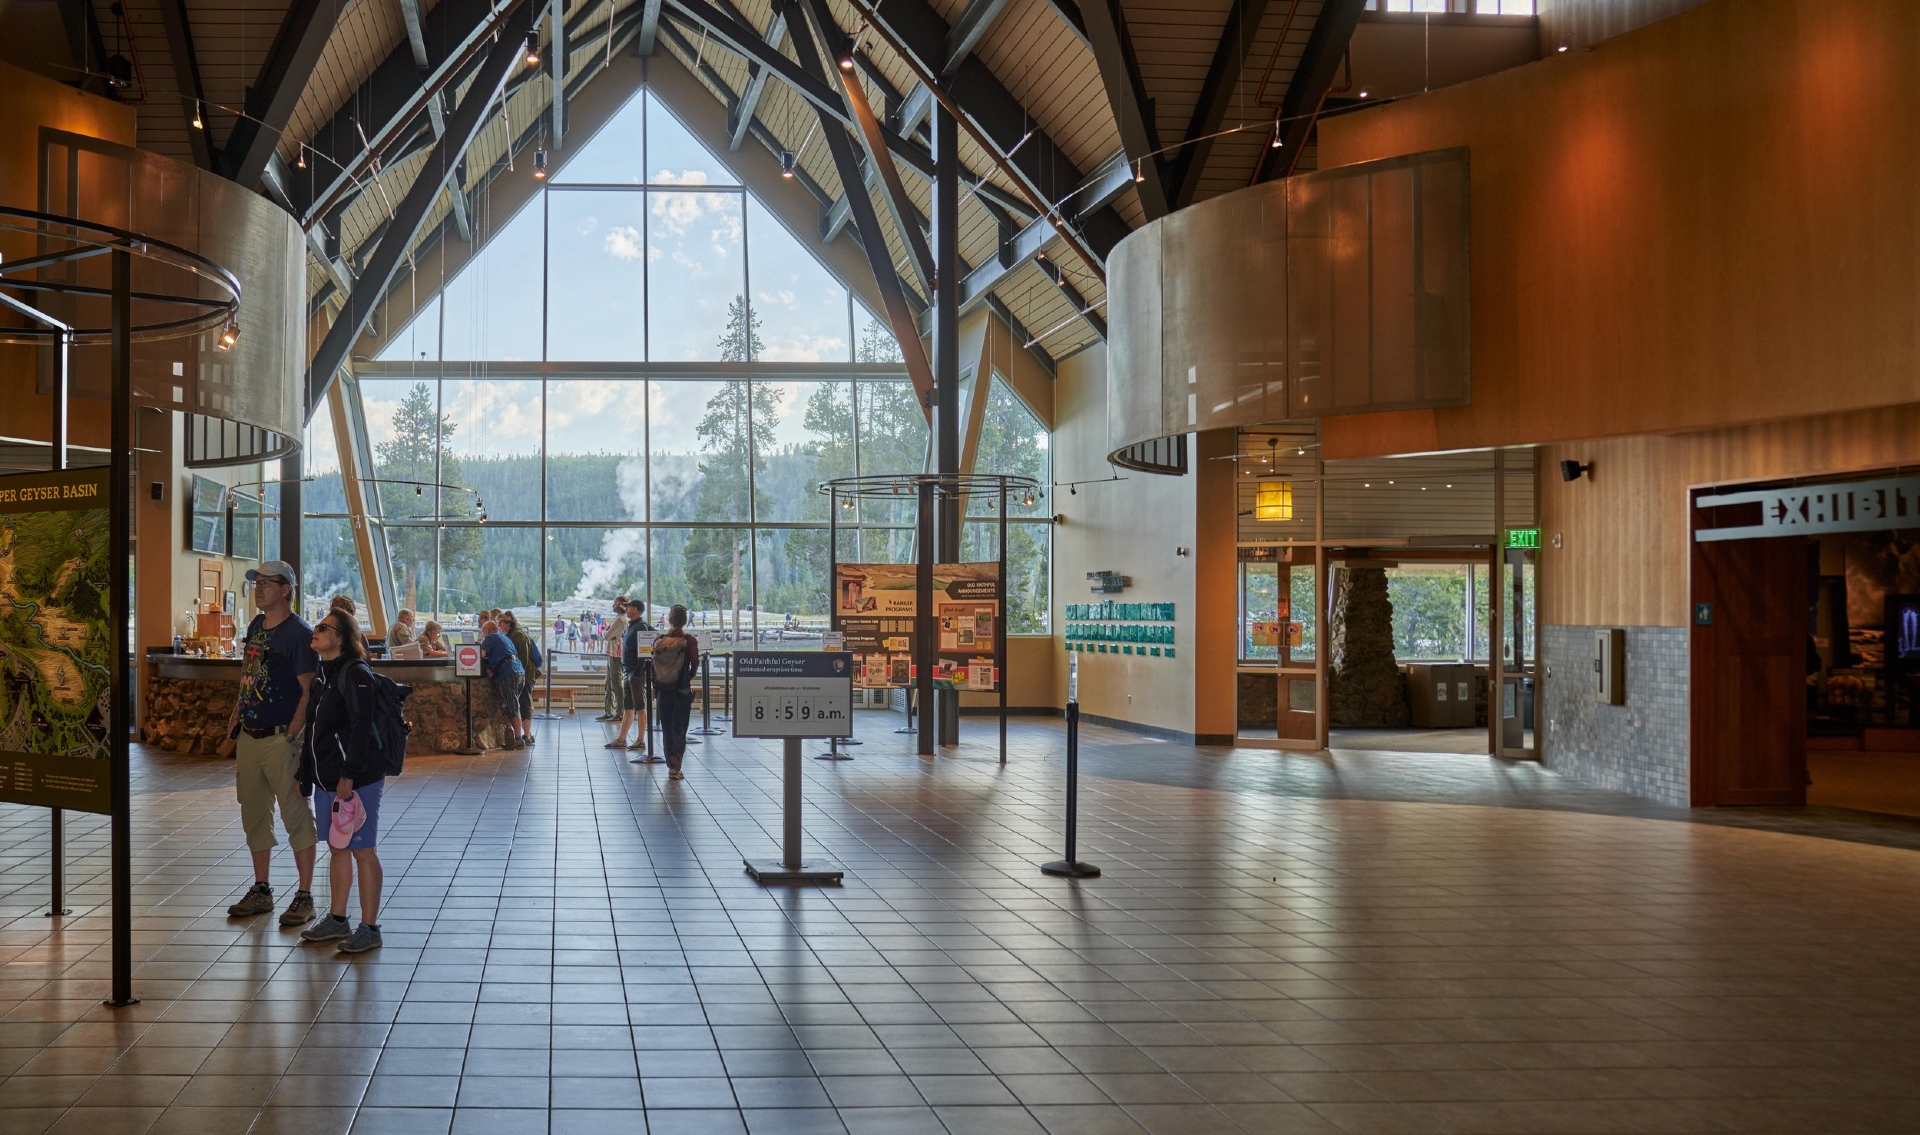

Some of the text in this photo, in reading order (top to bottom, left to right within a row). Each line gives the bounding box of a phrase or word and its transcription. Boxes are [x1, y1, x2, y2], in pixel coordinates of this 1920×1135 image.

[20, 487, 60, 501] GEYSER
[63, 484, 97, 499] BASIN
[1510, 530, 1538, 547] EXIT
[782, 658, 806, 667] Geyser
[817, 709, 846, 720] a.m.
